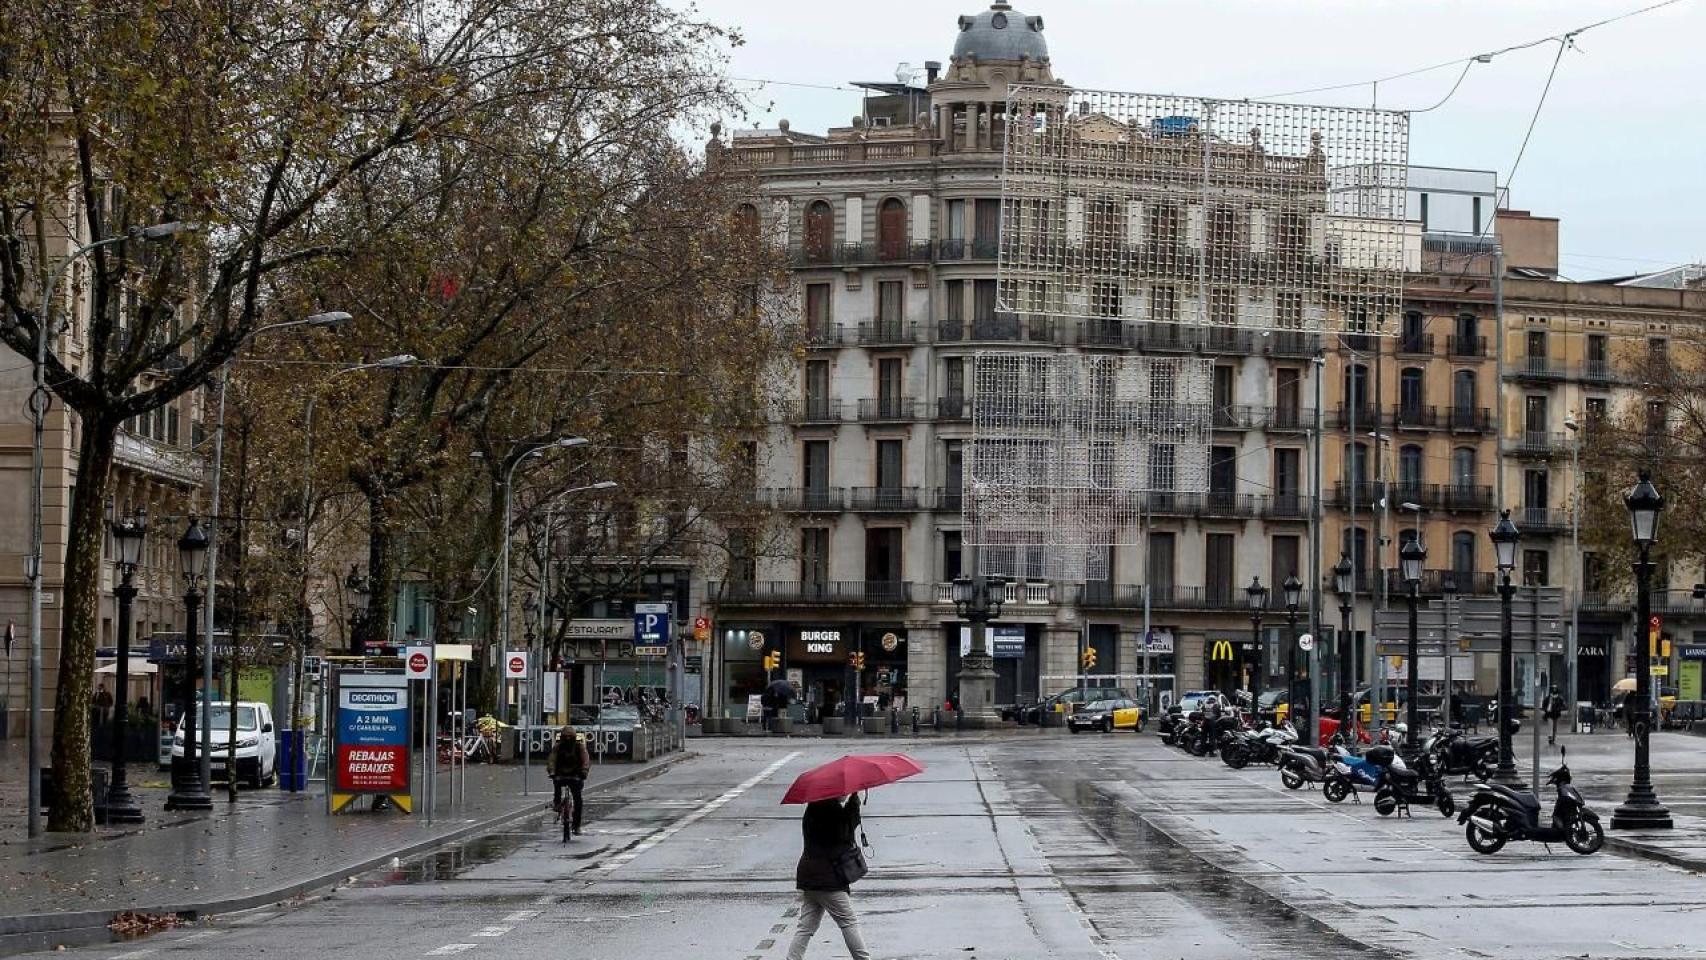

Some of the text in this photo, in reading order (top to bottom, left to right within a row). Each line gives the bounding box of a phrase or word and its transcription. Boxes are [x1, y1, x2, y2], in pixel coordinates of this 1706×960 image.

[646, 615, 657, 633] P
[563, 625, 625, 634] ESTAURANT
[801, 631, 840, 641] BURGER
[807, 643, 833, 653] KING
[1577, 646, 1605, 656] ZARA
[351, 694, 395, 703] DECATHLON
[356, 715, 389, 724] A 2 MIN
[348, 751, 395, 761] REBAJAS
[348, 763, 395, 773] REBAIXES
